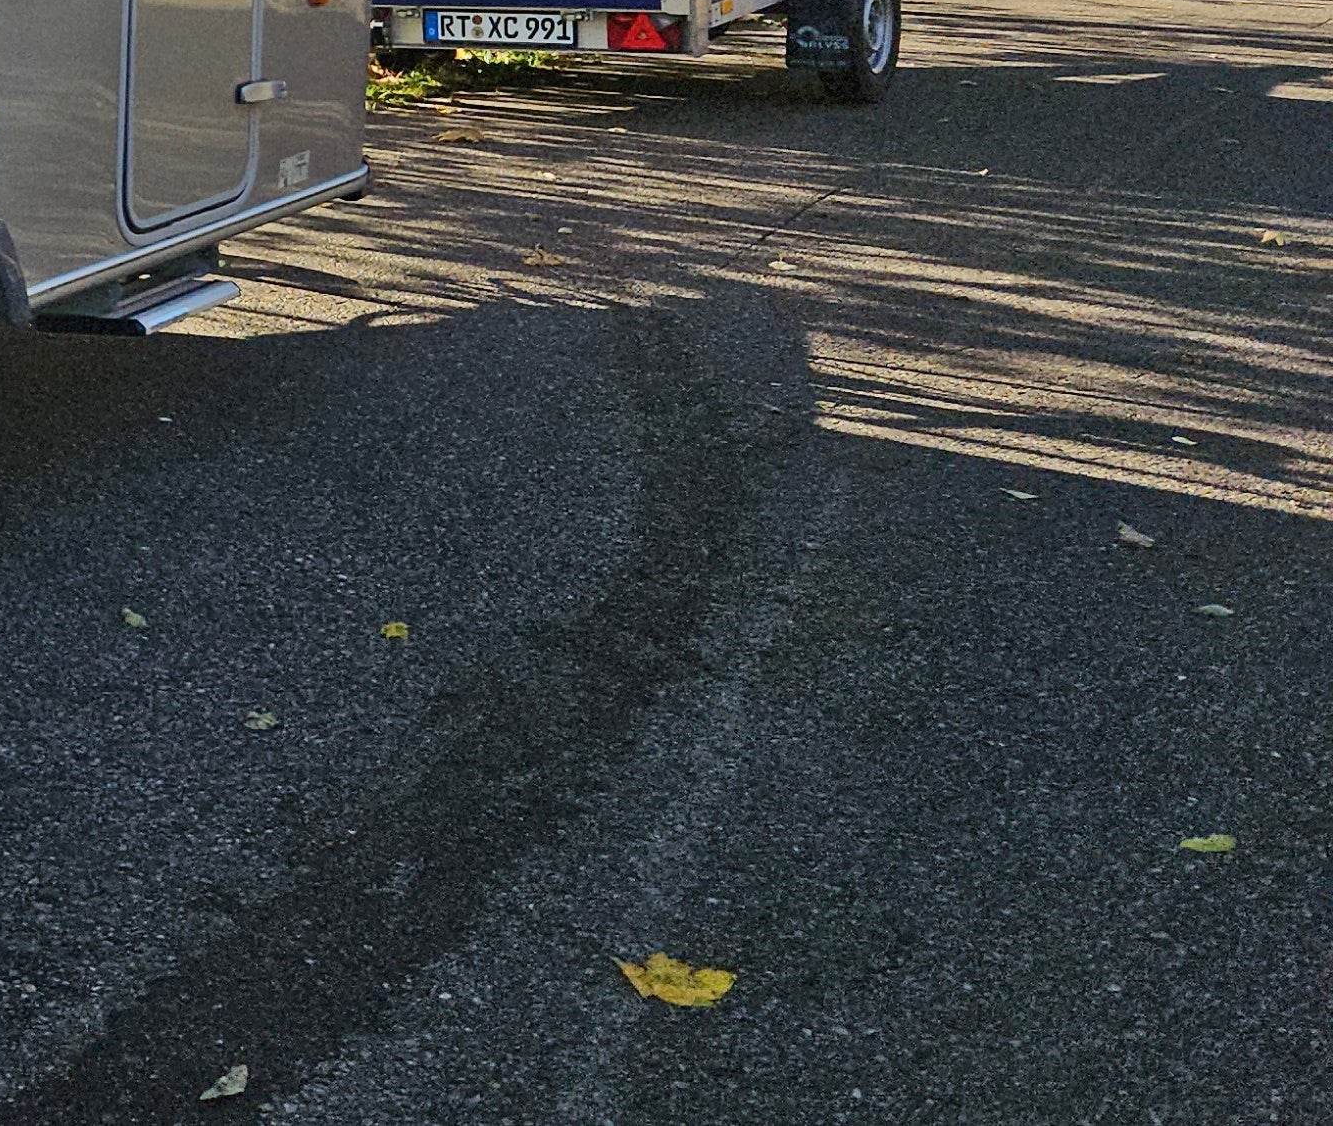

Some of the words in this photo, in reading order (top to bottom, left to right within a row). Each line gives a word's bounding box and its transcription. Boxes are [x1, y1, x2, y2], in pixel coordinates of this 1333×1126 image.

[440, 15, 471, 38] RT
[488, 16, 519, 39] XC
[525, 17, 571, 40] 991
